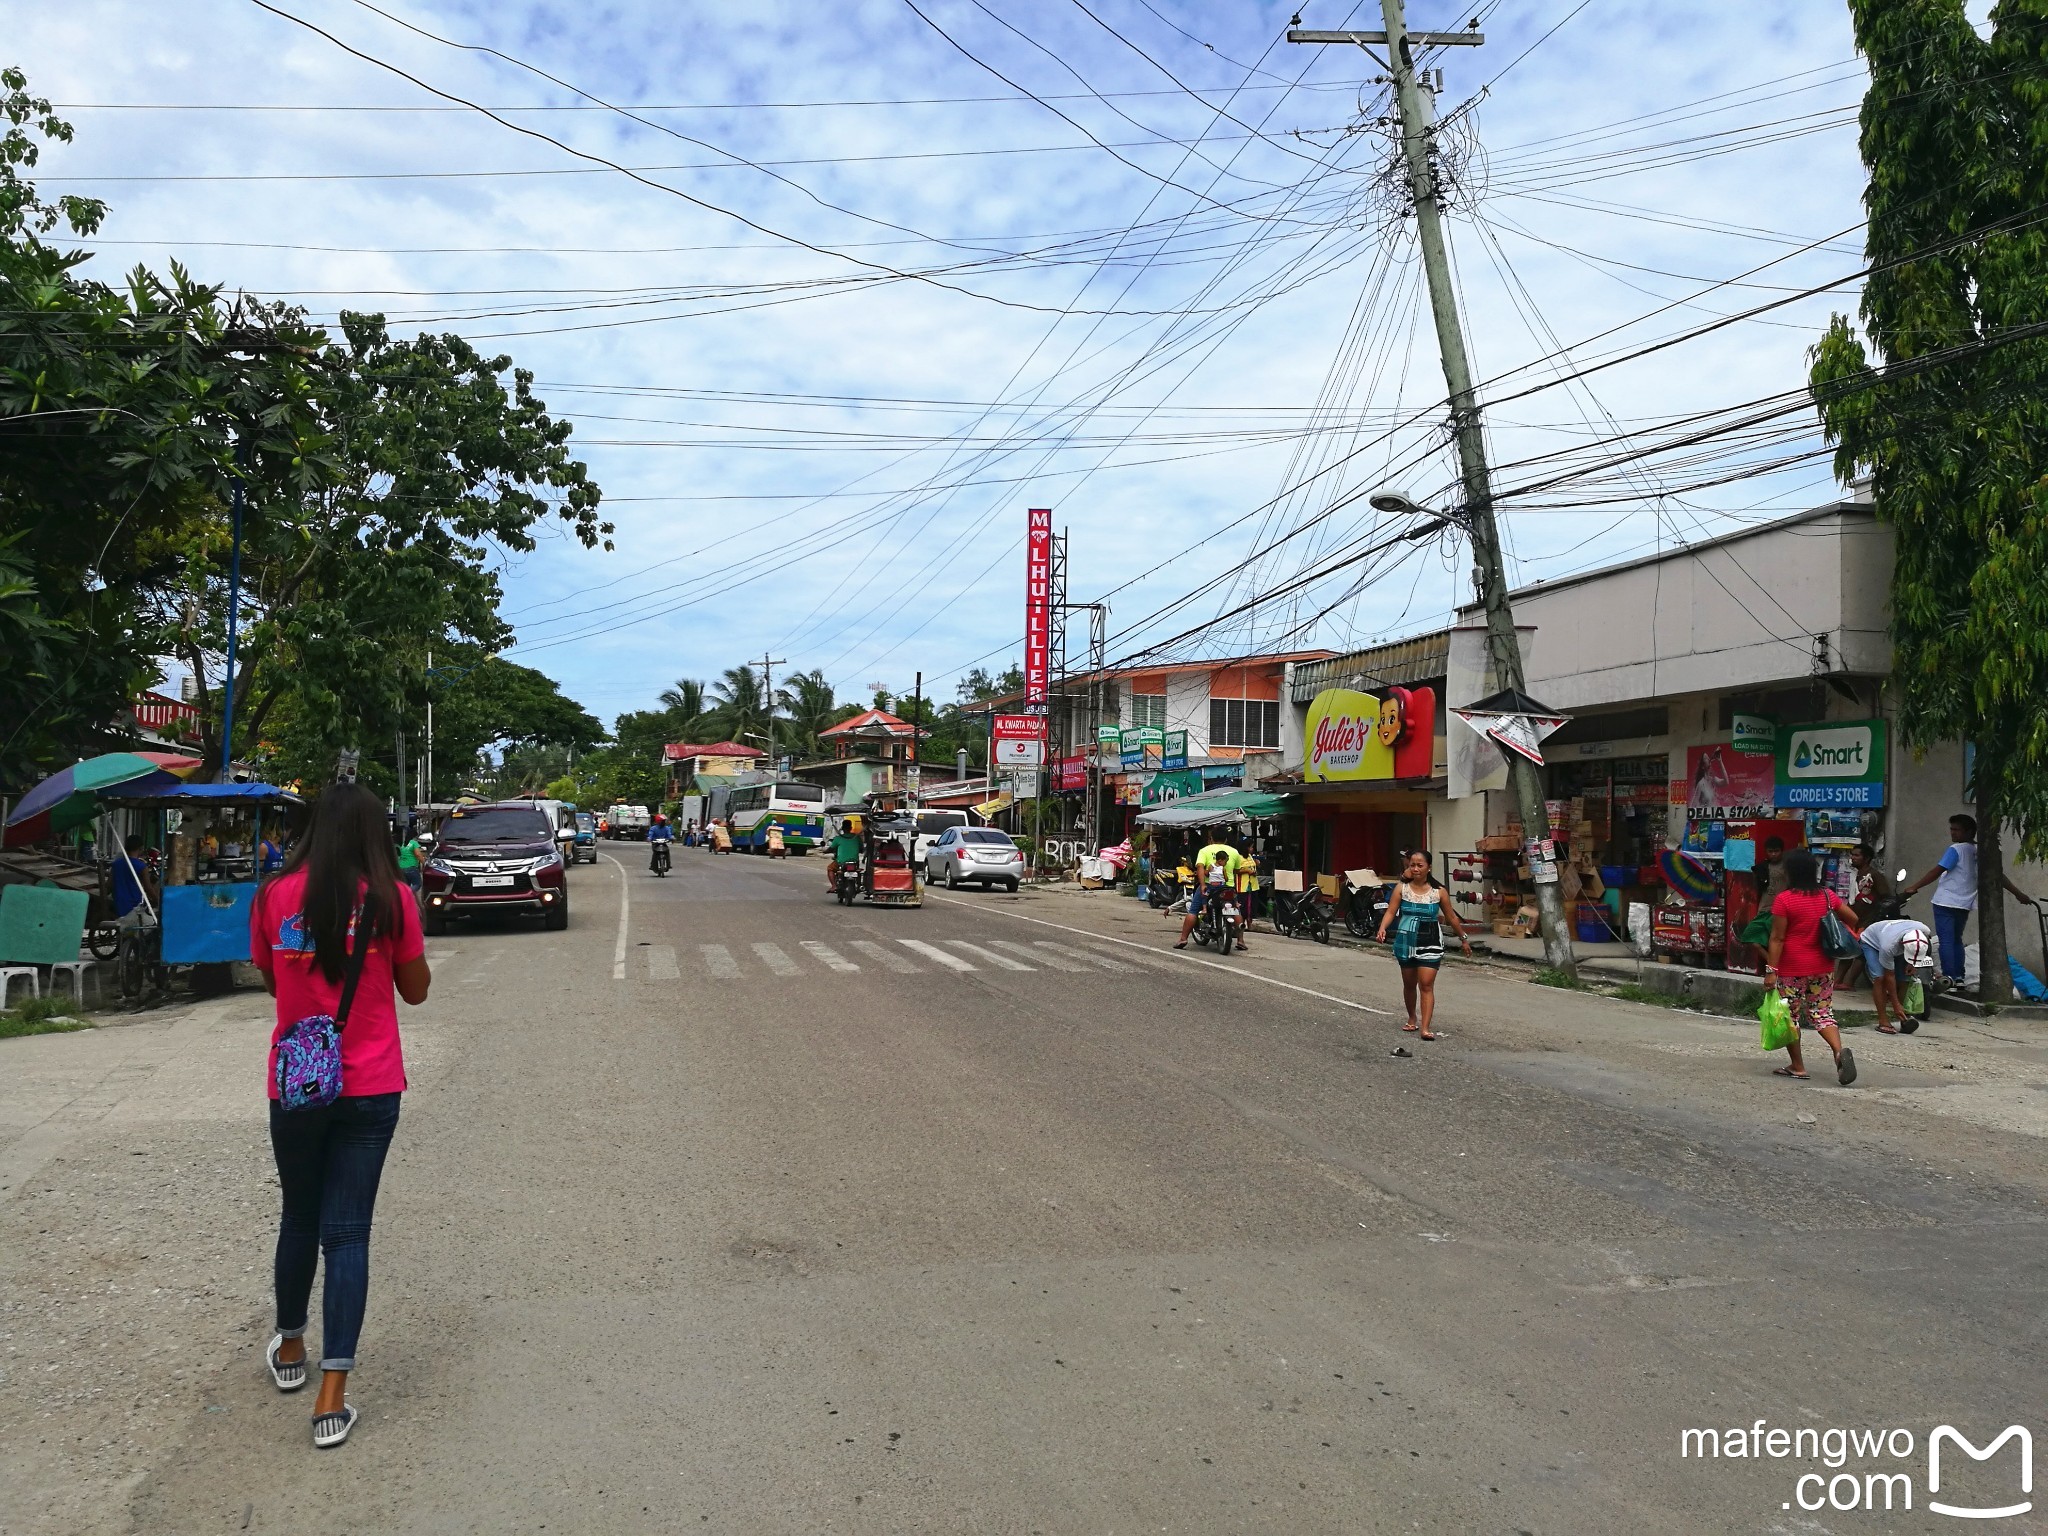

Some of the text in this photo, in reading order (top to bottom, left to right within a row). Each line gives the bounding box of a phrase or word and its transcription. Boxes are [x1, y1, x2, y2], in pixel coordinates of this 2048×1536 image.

[1005, 720, 1026, 730] KWARTA
[1745, 724, 1773, 736] Smart
[1314, 716, 1369, 764] Julie's
[1734, 742, 1750, 750] LOAD
[1813, 741, 1864, 766] Smart
[1330, 755, 1359, 765] BAKESHOP
[1789, 787, 1869, 802] CORDEL'S STORE
[1687, 807, 1725, 820] DELIA
